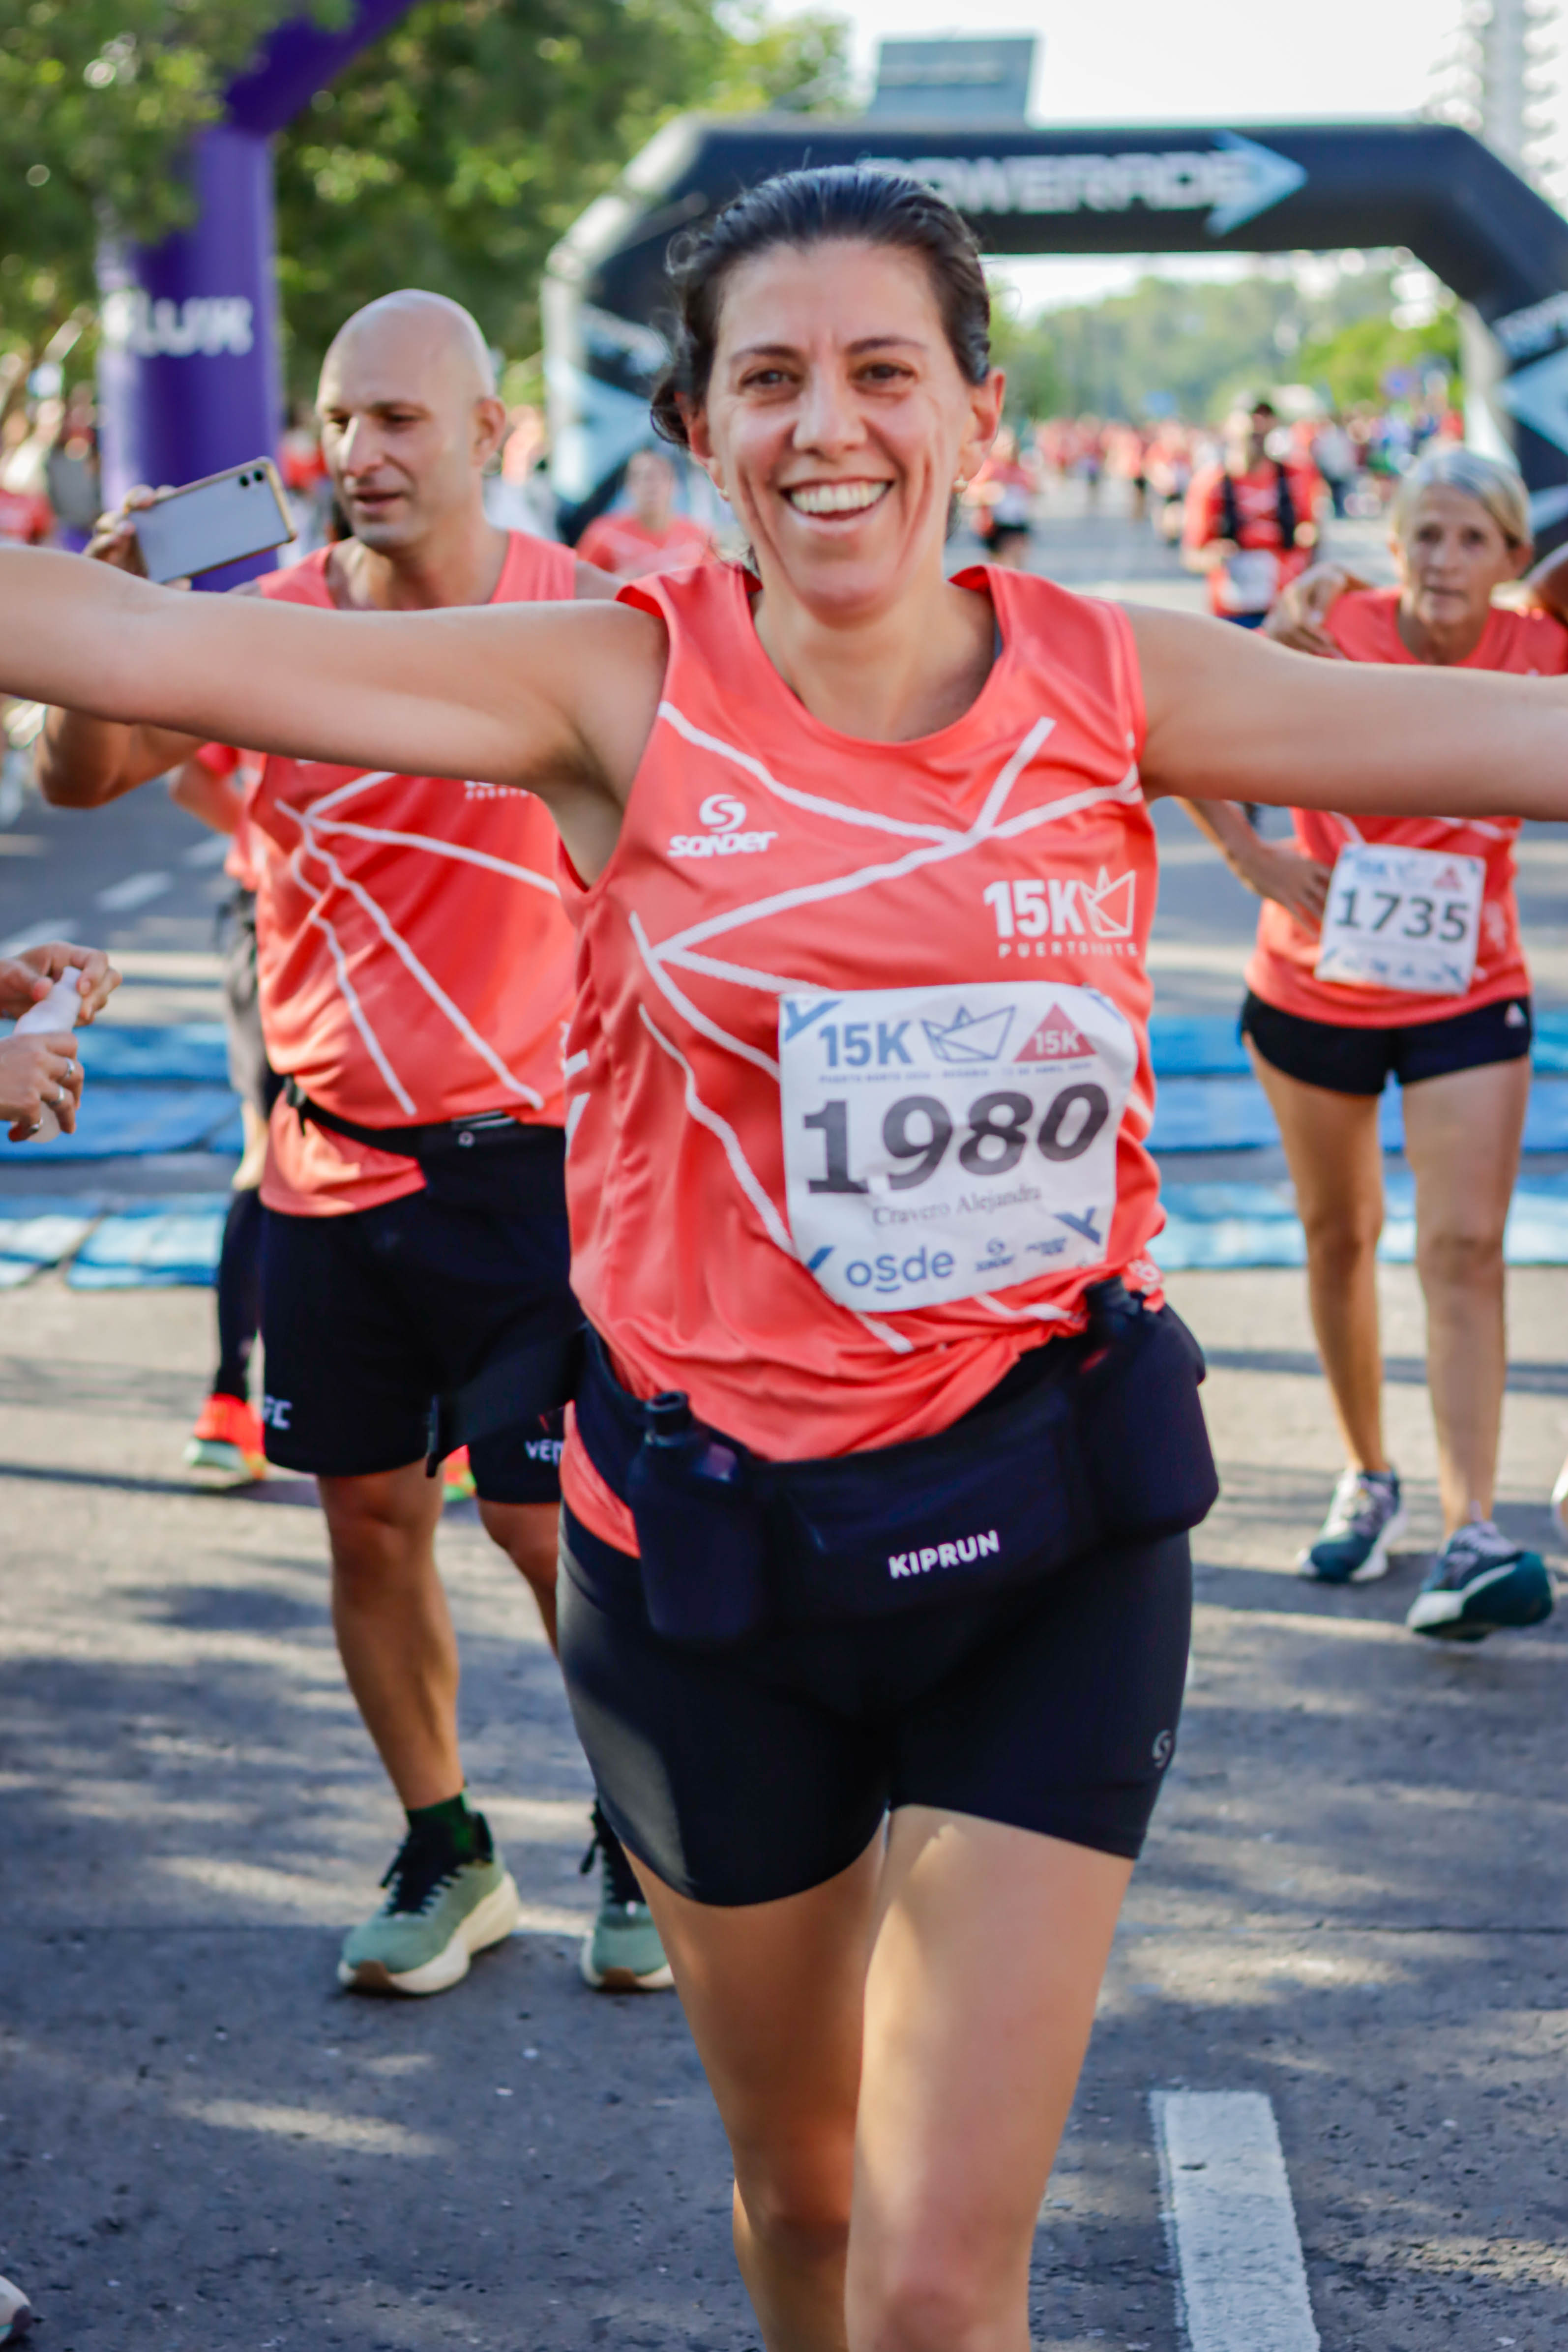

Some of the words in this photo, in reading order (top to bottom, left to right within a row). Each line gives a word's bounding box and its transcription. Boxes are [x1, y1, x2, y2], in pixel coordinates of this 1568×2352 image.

[859, 151, 1257, 215] OWERADE
[983, 878, 1085, 938] 15K
[1335, 886, 1469, 943] 1735
[818, 1021, 913, 1068] 15K
[1034, 1030, 1080, 1055] 15K
[803, 1083, 1109, 1194] 1980
[846, 1245, 954, 1287] osde
[888, 1529, 1000, 1579] KIPRUN
